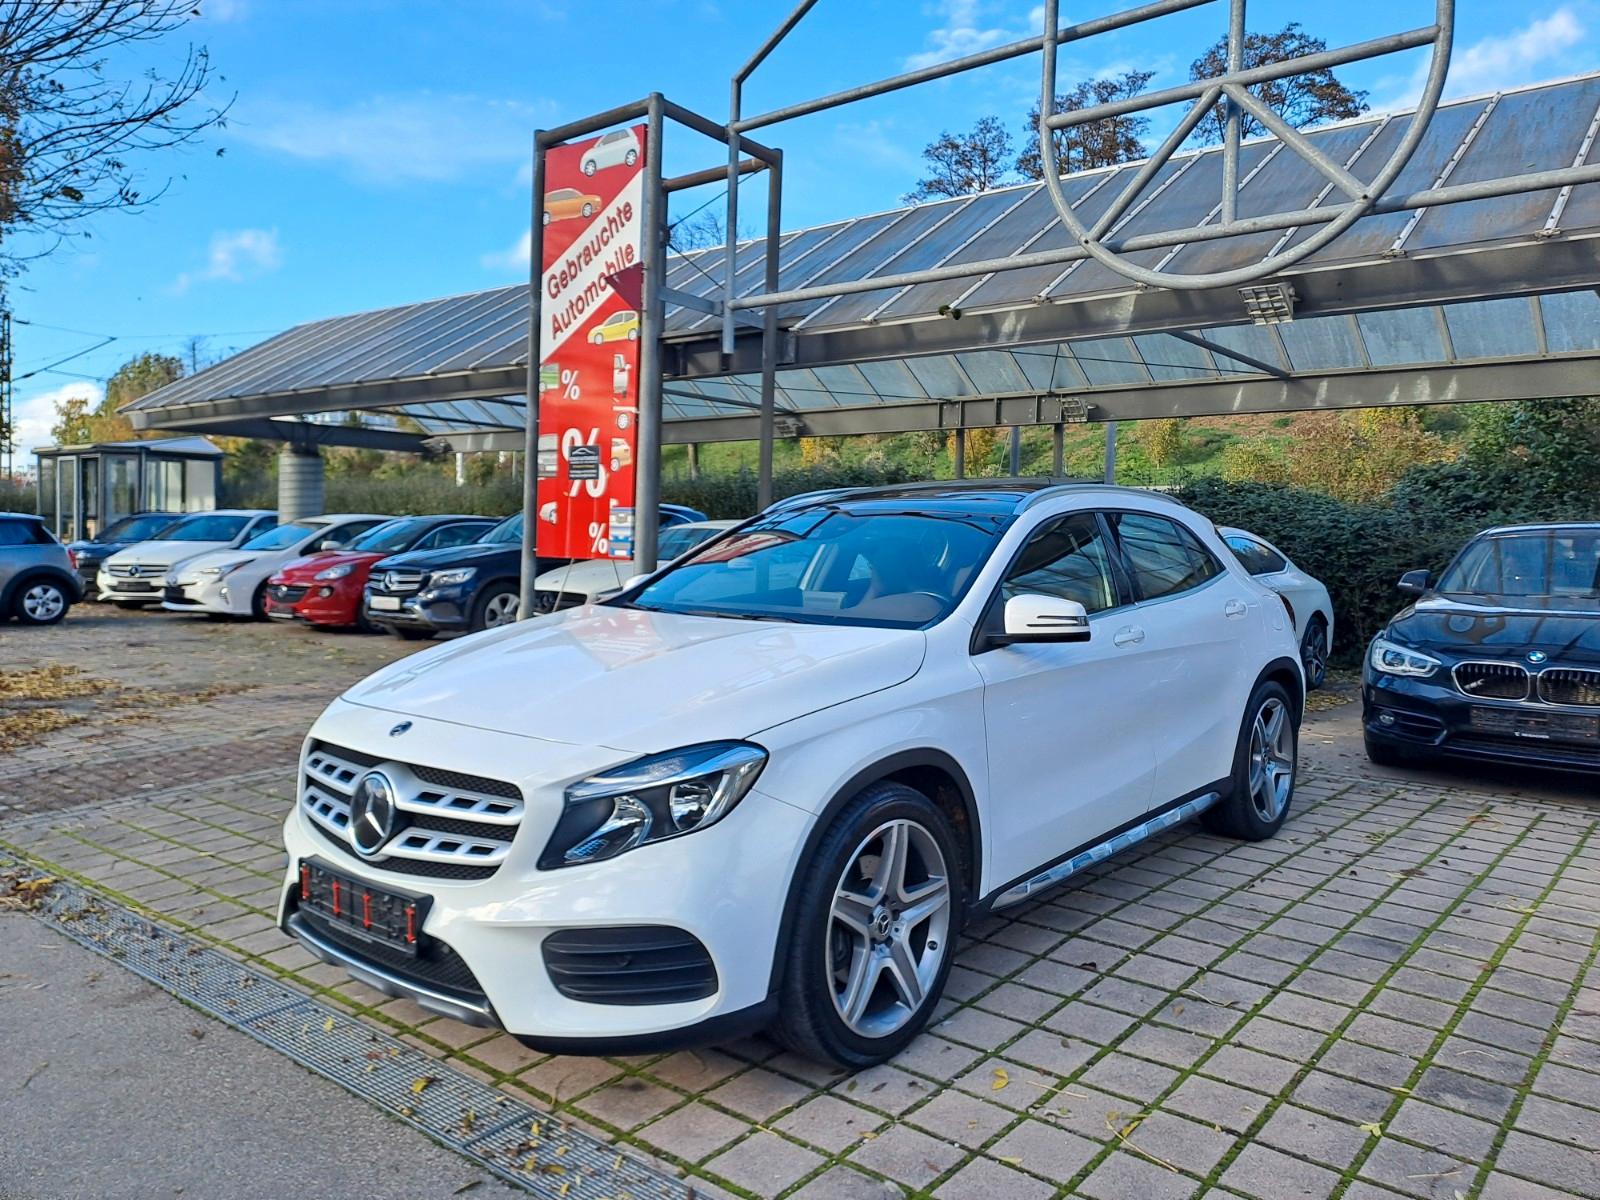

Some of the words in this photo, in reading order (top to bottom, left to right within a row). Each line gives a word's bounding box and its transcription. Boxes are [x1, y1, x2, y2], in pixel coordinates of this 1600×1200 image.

[547, 201, 633, 300] Gebrauchte
[561, 369, 581, 401] %
[588, 521, 608, 554] %
